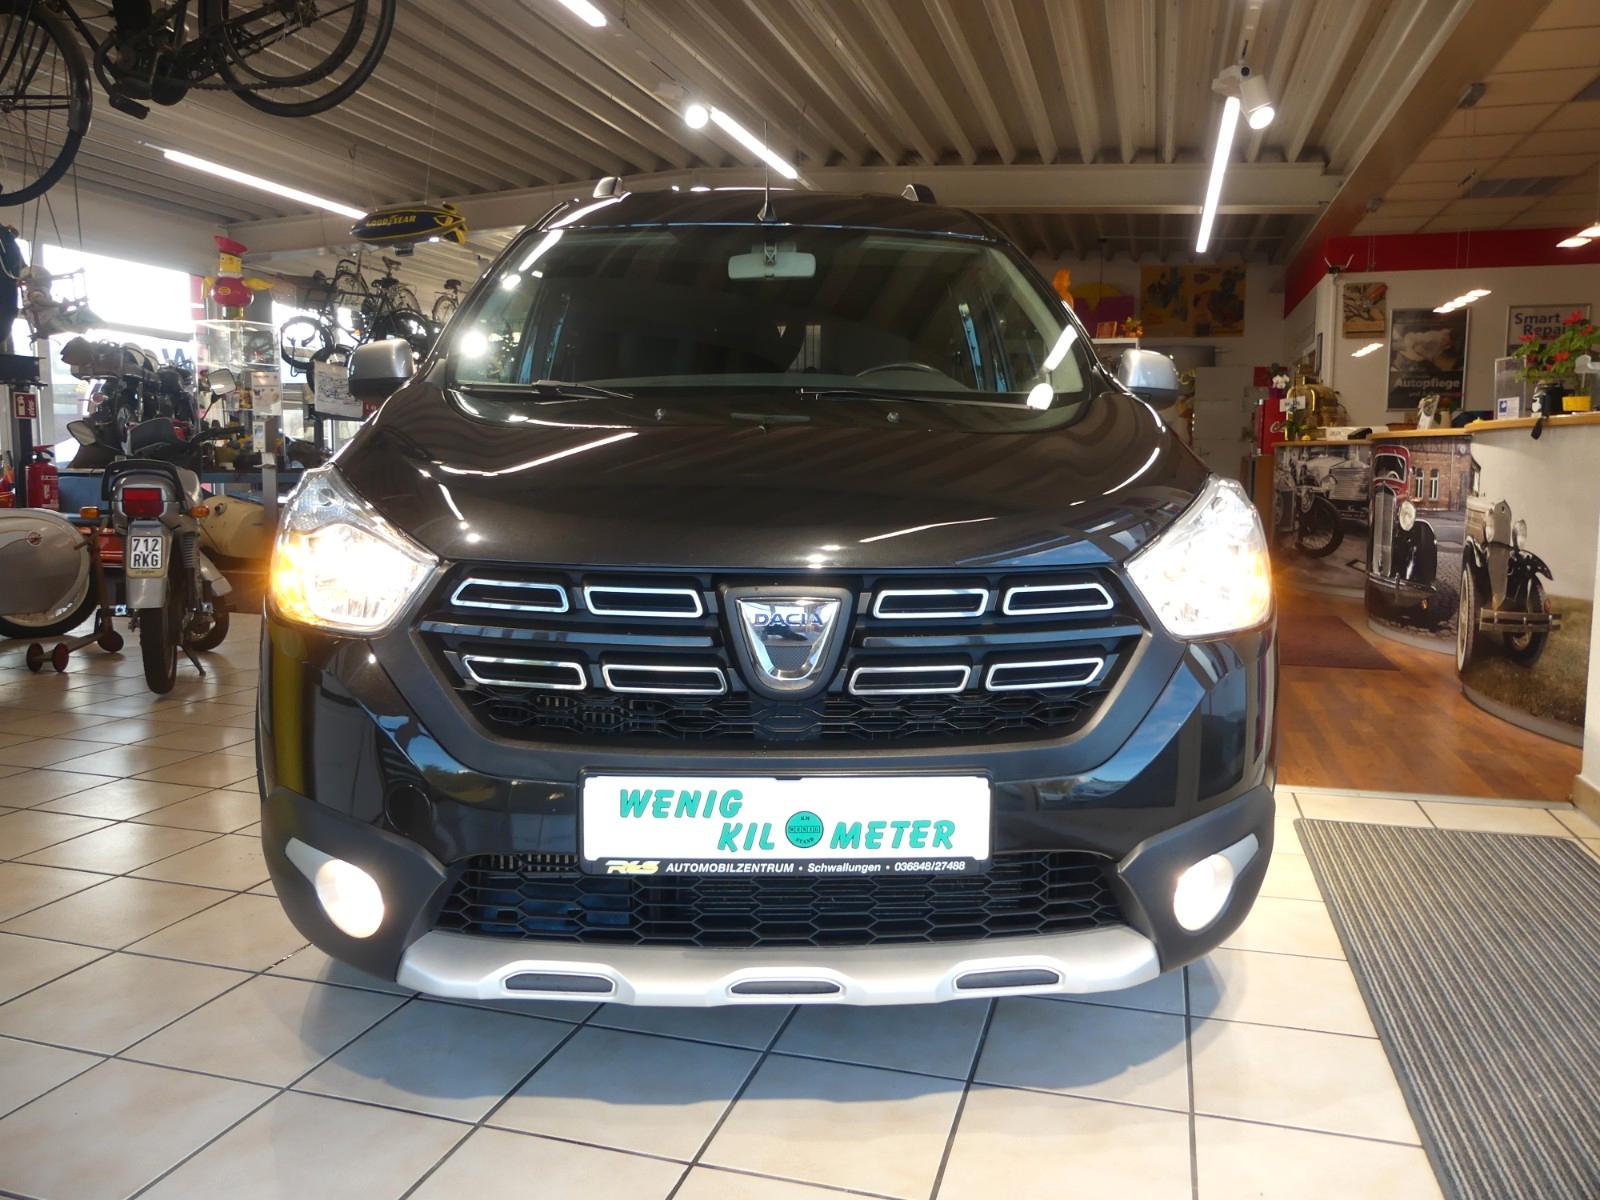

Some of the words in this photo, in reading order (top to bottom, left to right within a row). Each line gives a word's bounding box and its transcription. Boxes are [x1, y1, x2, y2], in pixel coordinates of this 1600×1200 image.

[1514, 312, 1561, 325] Smart
[1395, 378, 1460, 390] Autopflege
[133, 538, 159, 552] 712
[133, 554, 159, 567] RKG
[754, 611, 823, 627] DACIA
[620, 789, 744, 818] WENIG
[665, 862, 795, 873] AUTOMOBILZENTRUM
[807, 862, 882, 874] Schwallungen
[894, 861, 966, 872] 036848/27488
